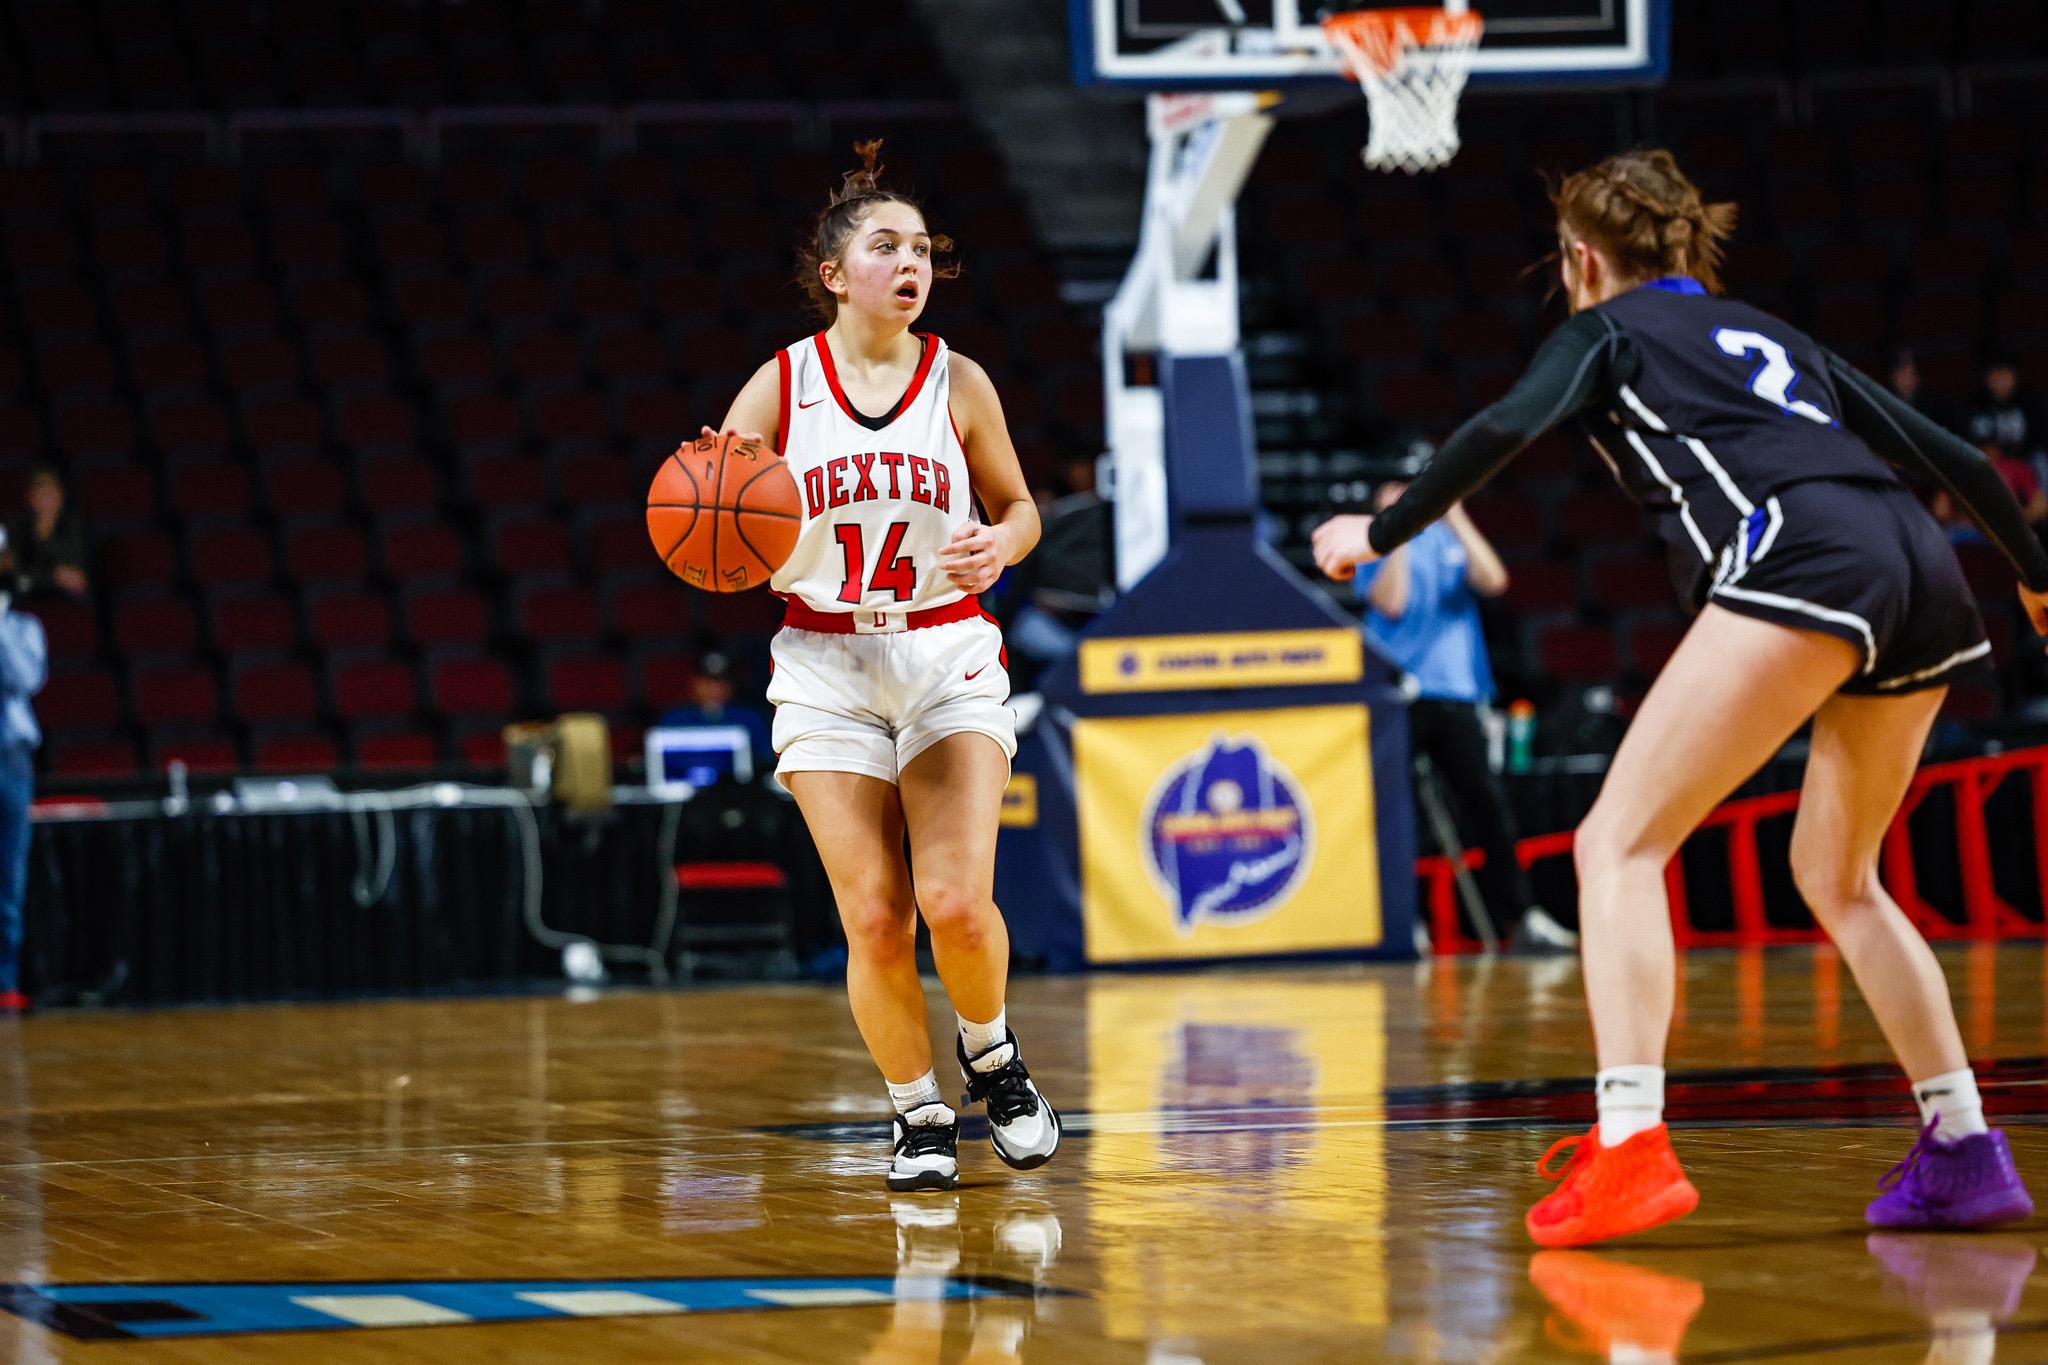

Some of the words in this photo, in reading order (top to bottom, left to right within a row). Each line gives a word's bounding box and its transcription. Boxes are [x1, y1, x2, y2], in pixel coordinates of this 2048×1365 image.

[1711, 325, 1840, 428] 2
[804, 452, 951, 520] DEXTER
[834, 522, 916, 604] 14
